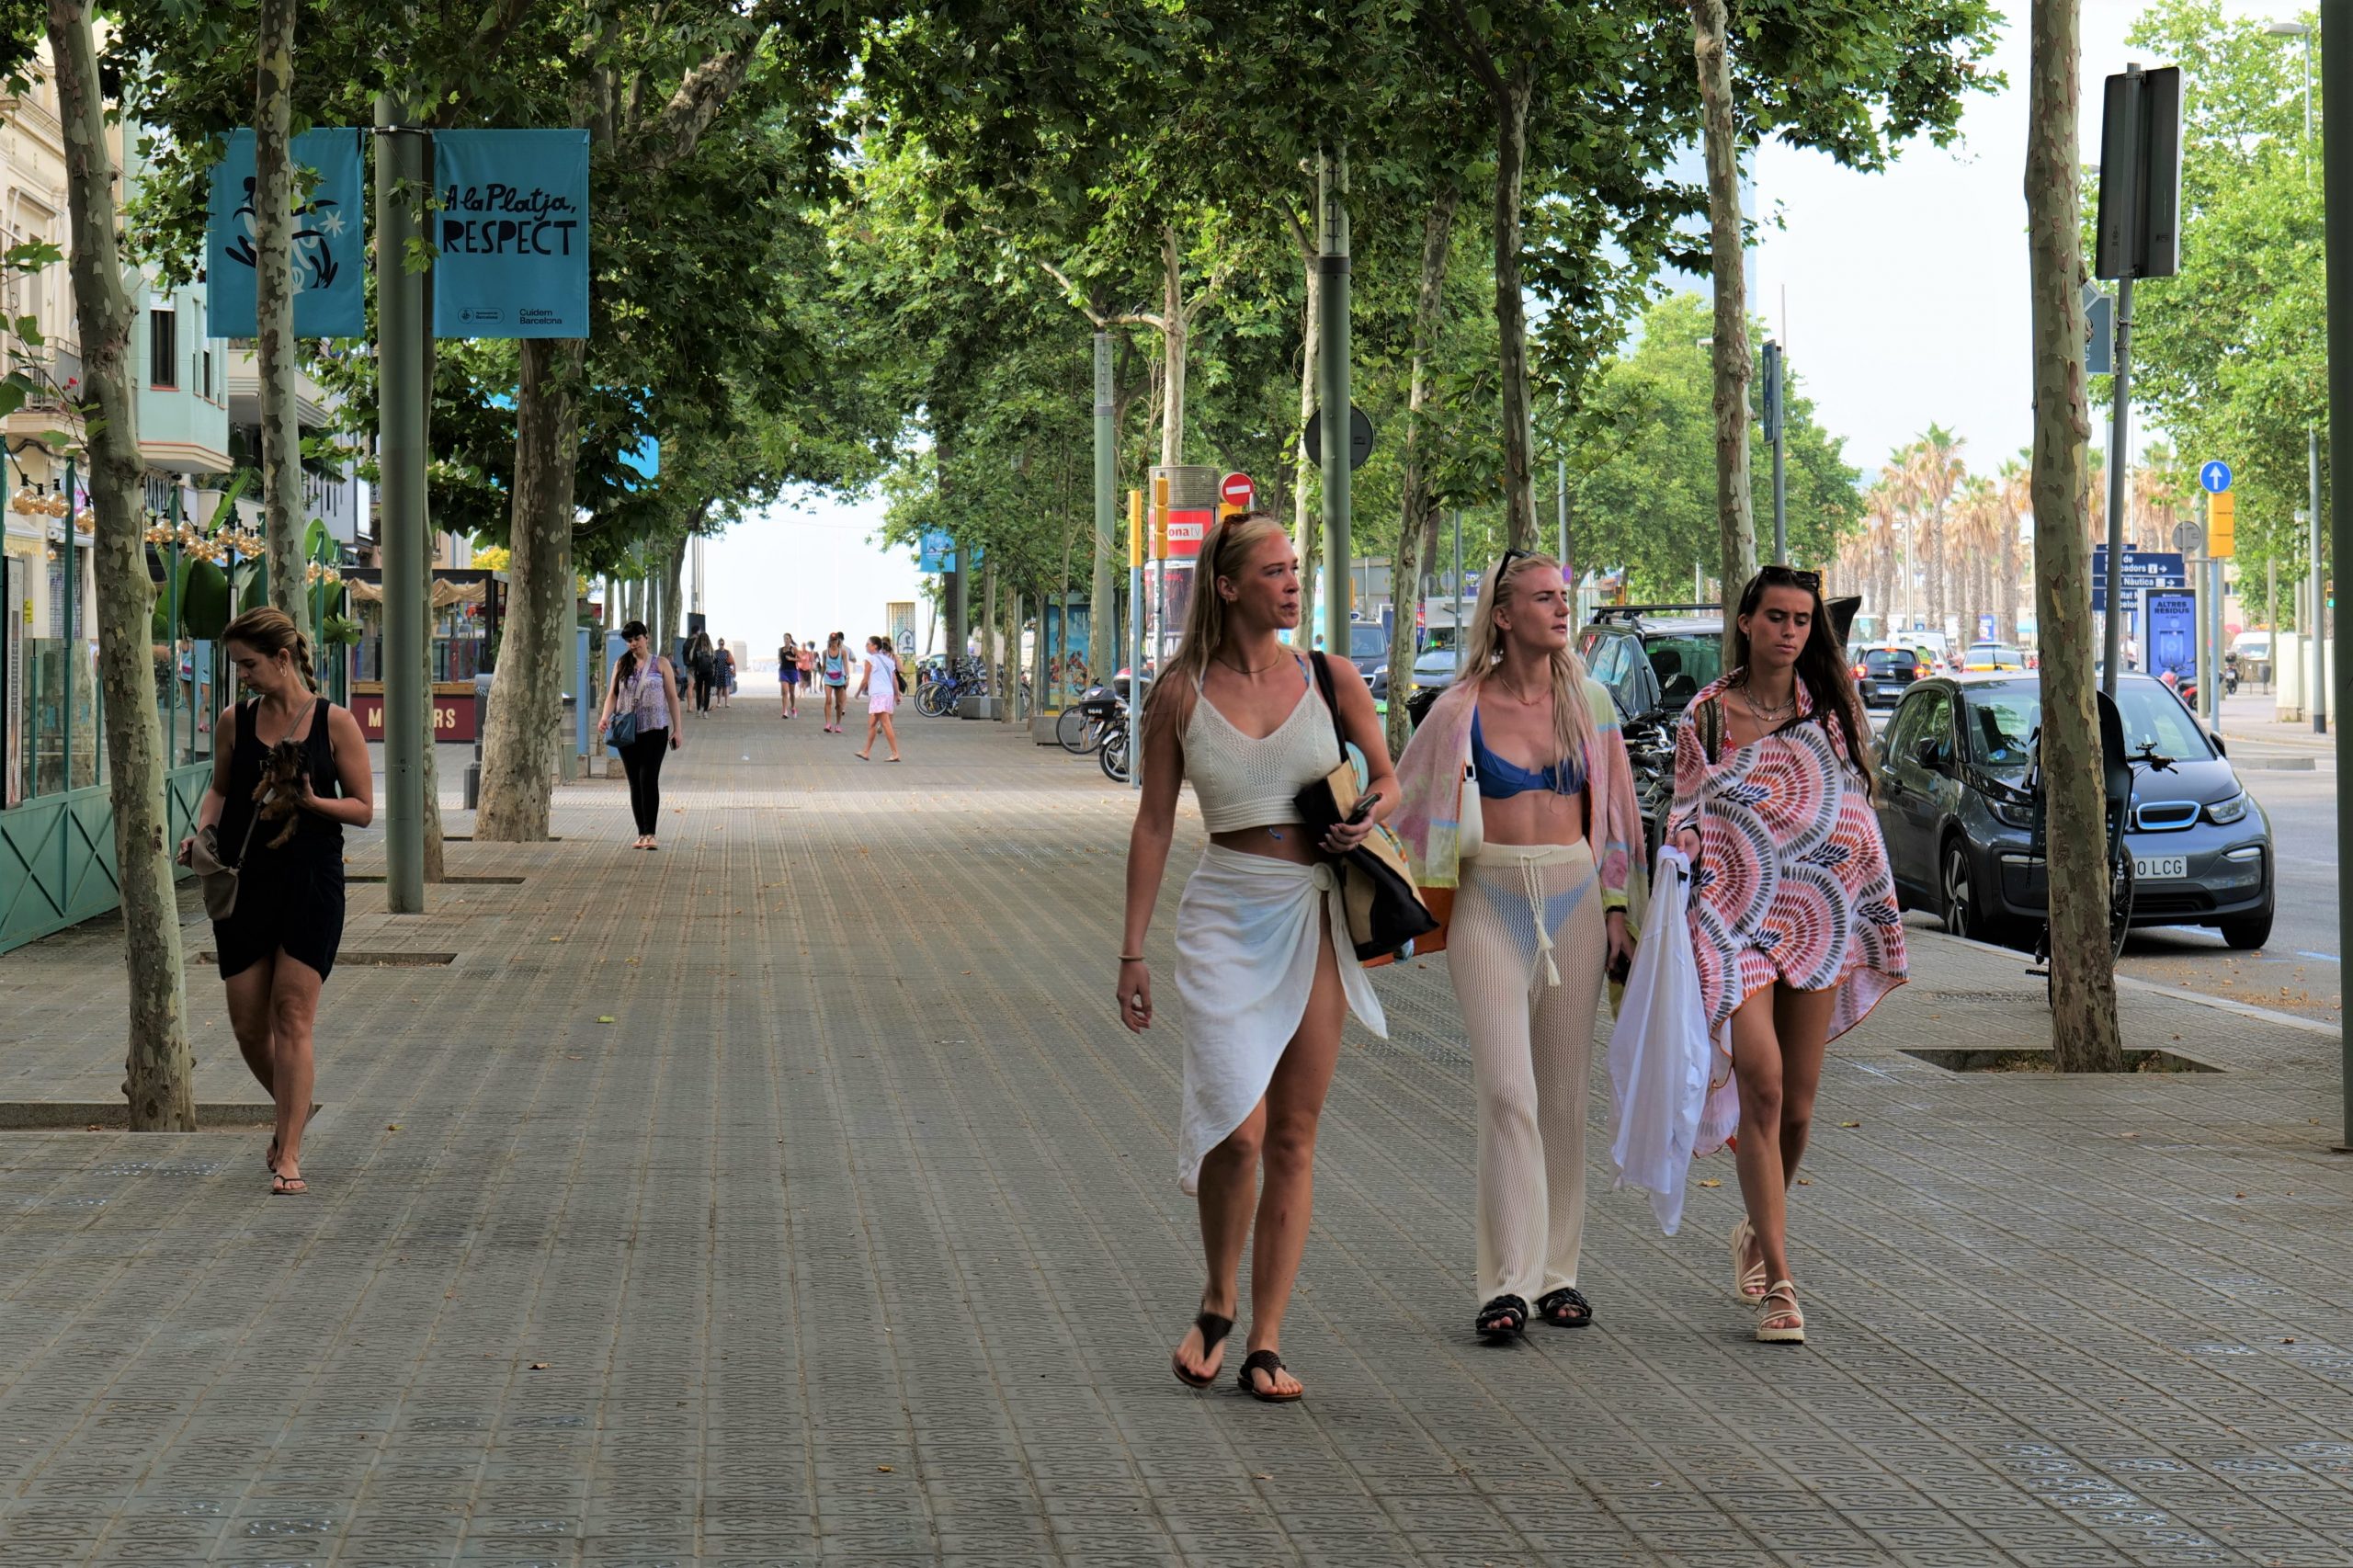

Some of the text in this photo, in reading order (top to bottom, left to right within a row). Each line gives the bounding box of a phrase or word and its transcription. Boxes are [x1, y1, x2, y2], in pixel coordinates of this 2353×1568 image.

[445, 184, 576, 222] A la Platja,
[443, 220, 577, 256] RESPECT
[1765, 357, 1770, 393] P
[2123, 554, 2133, 563] de
[2152, 860, 2182, 875] LCG
